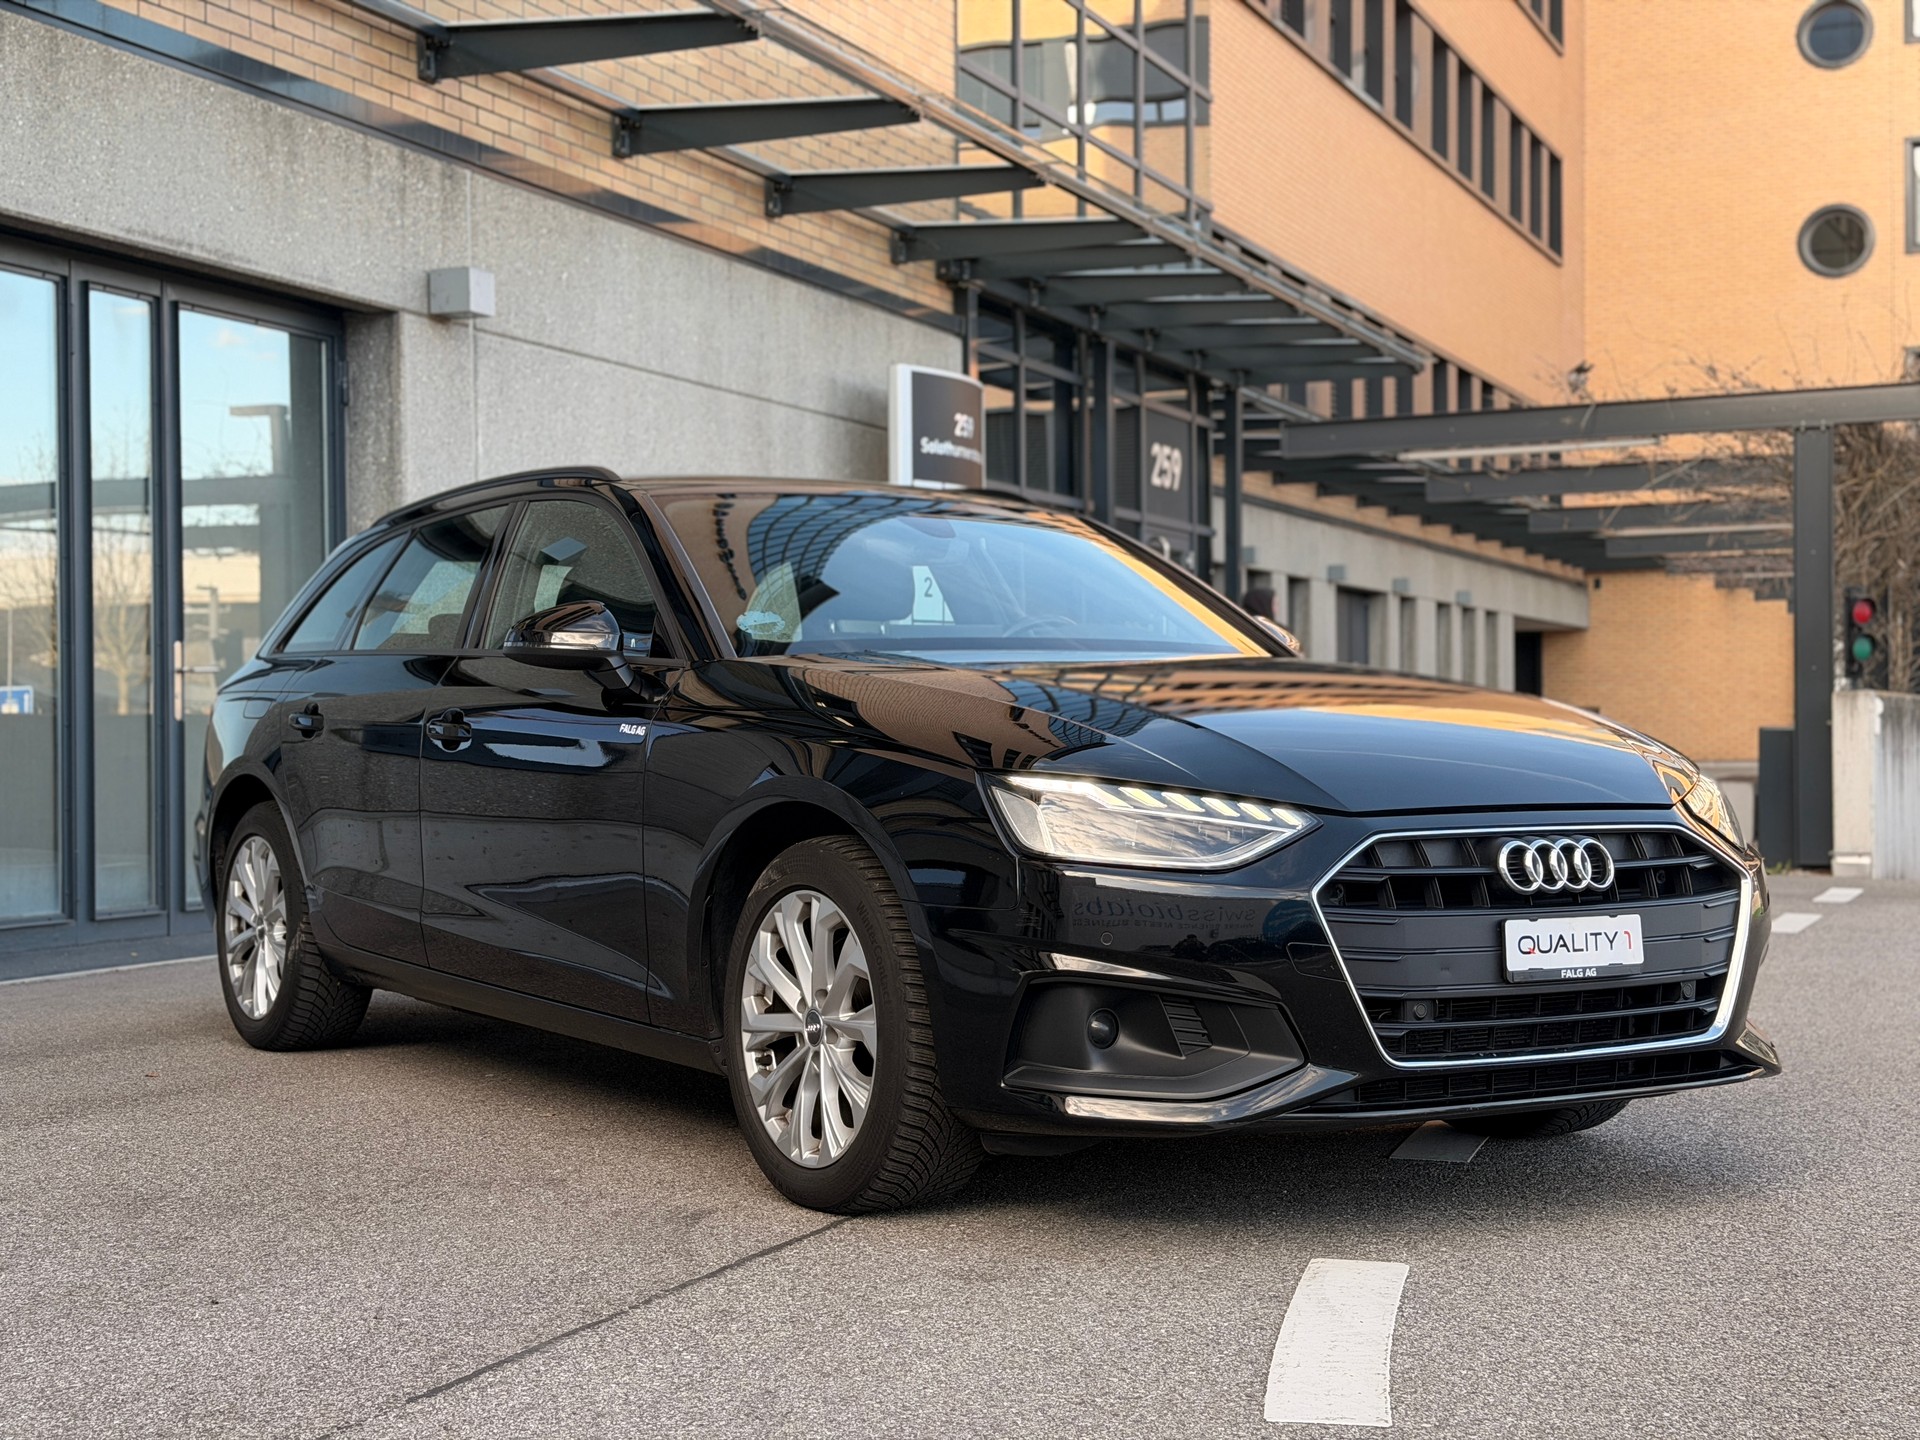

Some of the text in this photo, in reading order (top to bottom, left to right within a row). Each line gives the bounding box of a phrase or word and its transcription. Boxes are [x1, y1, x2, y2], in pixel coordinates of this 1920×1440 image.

[1150, 442, 1183, 492] 259
[923, 577, 934, 598] 2
[619, 723, 646, 736] FALG AG
[1517, 931, 1633, 955] QUALITY 1
[1561, 967, 1597, 979] FALG AG
